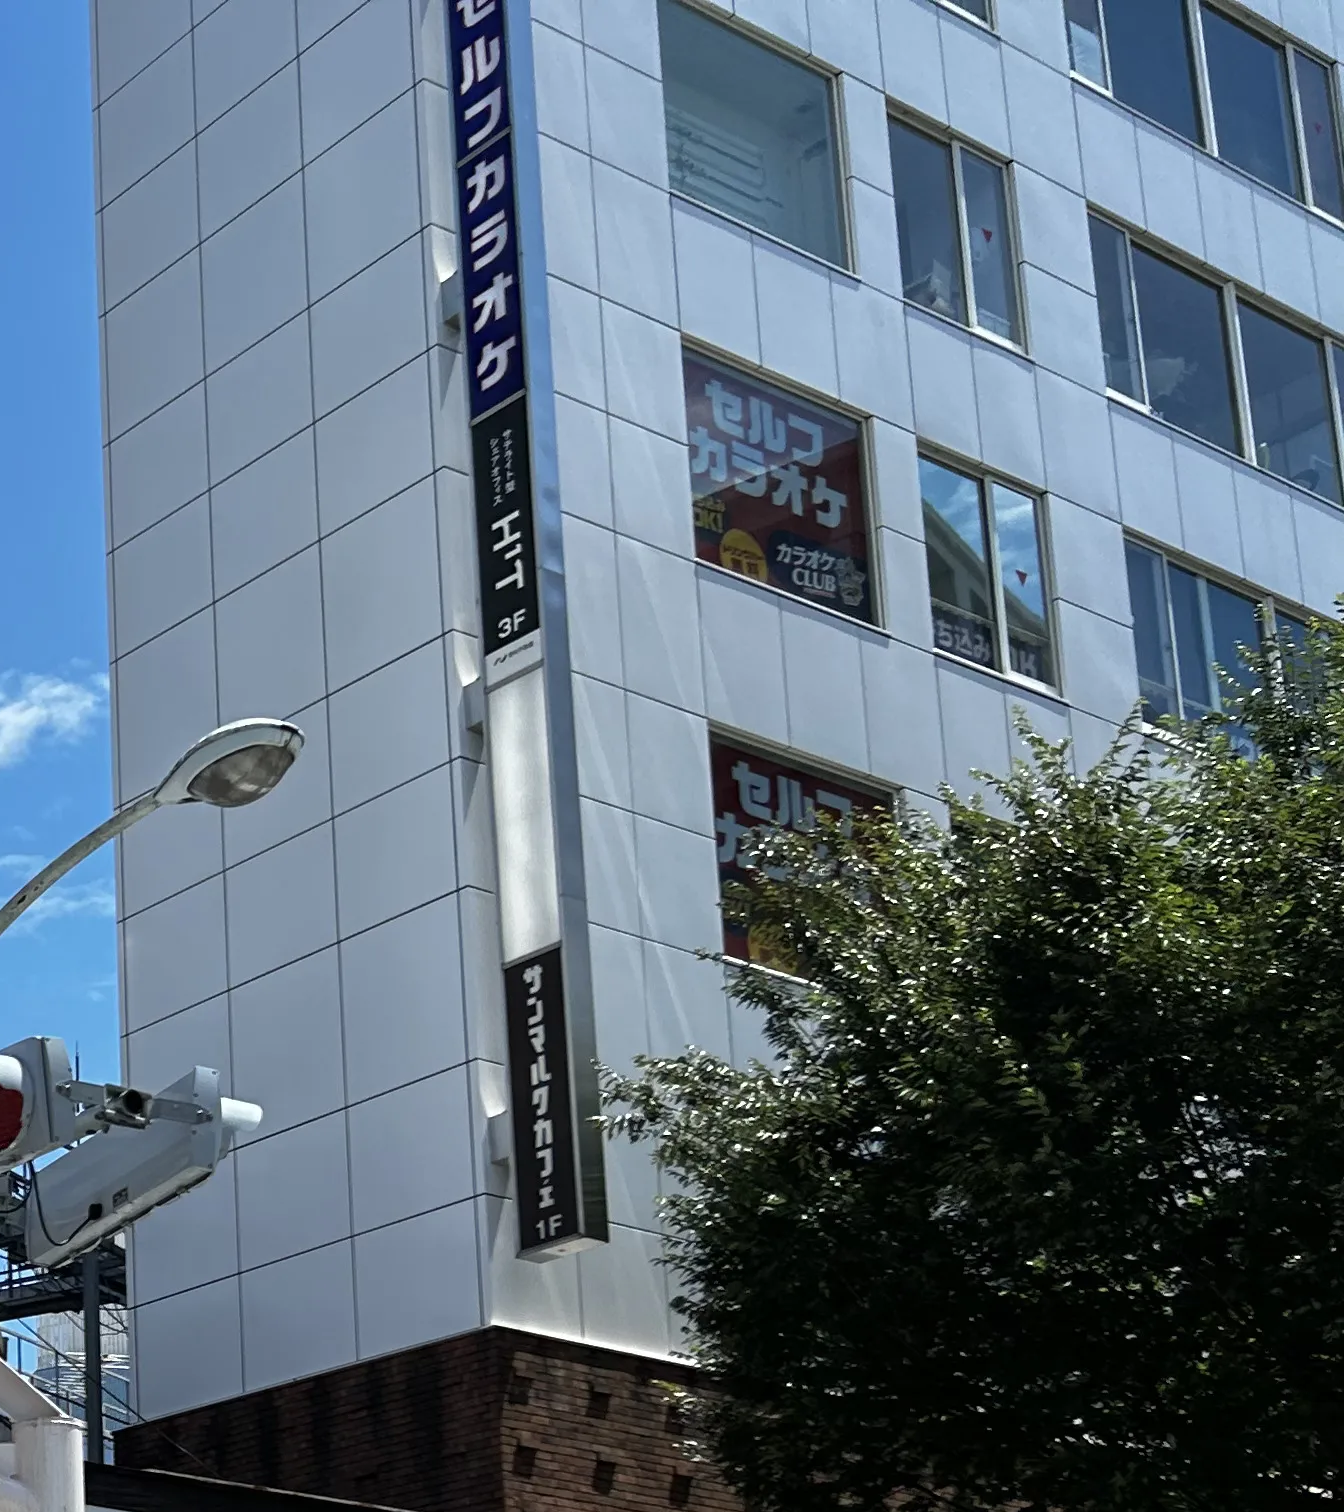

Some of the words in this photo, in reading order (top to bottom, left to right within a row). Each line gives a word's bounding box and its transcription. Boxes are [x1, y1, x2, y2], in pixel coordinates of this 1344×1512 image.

[705, 379, 824, 468] セルフ
[690, 425, 848, 529] カラオケ
[775, 542, 837, 572] カラオケ
[791, 567, 838, 592] CLUB
[497, 608, 528, 640] 3F
[523, 964, 556, 1211] サンマルクカフェ
[535, 1214, 563, 1240] 1F
